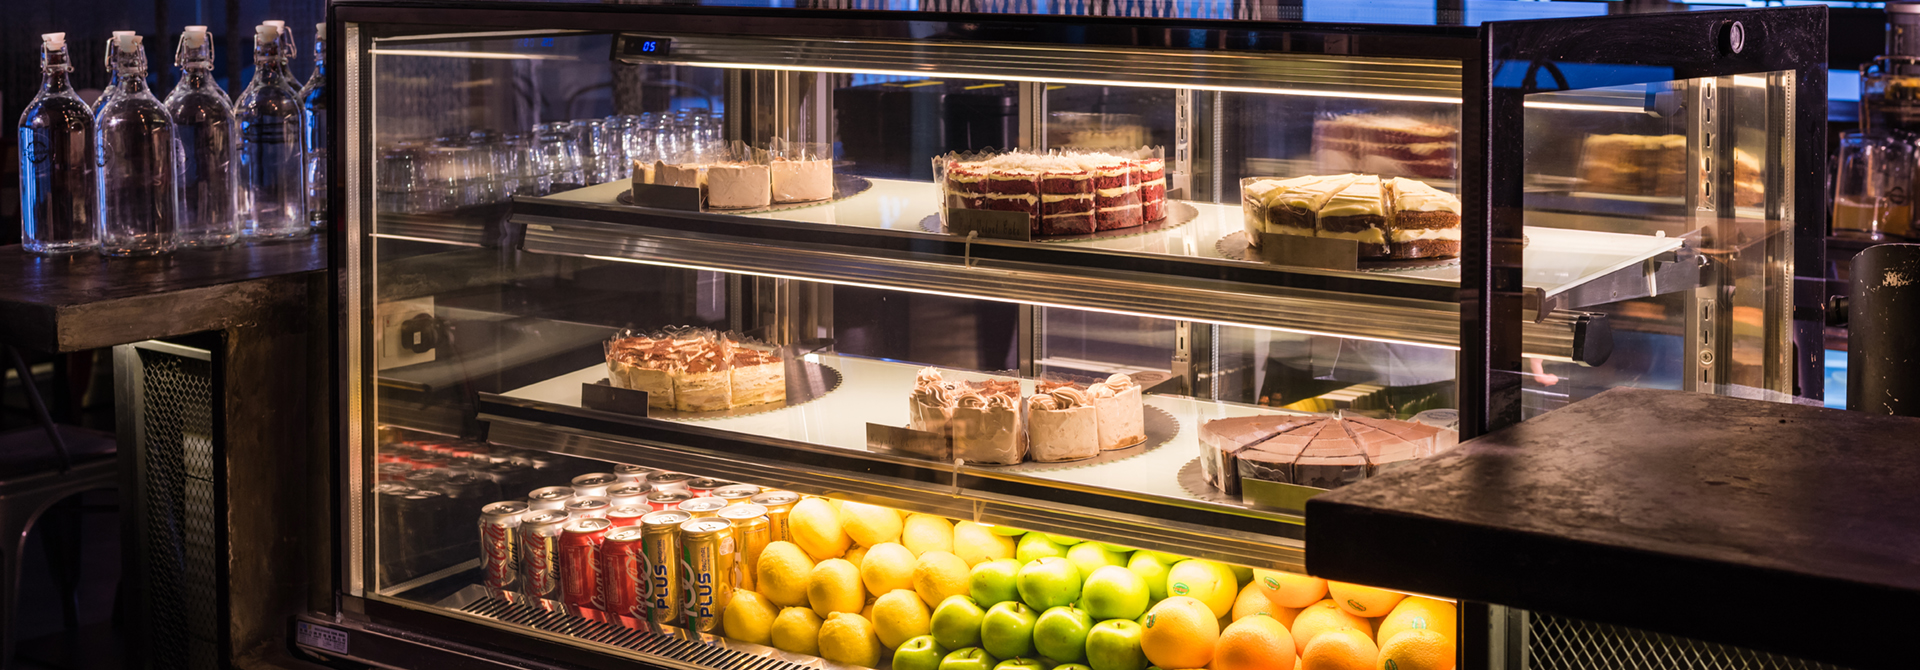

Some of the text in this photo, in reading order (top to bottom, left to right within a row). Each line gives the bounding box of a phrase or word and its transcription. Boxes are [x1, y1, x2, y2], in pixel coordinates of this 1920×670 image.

[642, 40, 656, 52] 05
[654, 565, 669, 609] PLUS
[697, 573, 714, 618] PLUS
